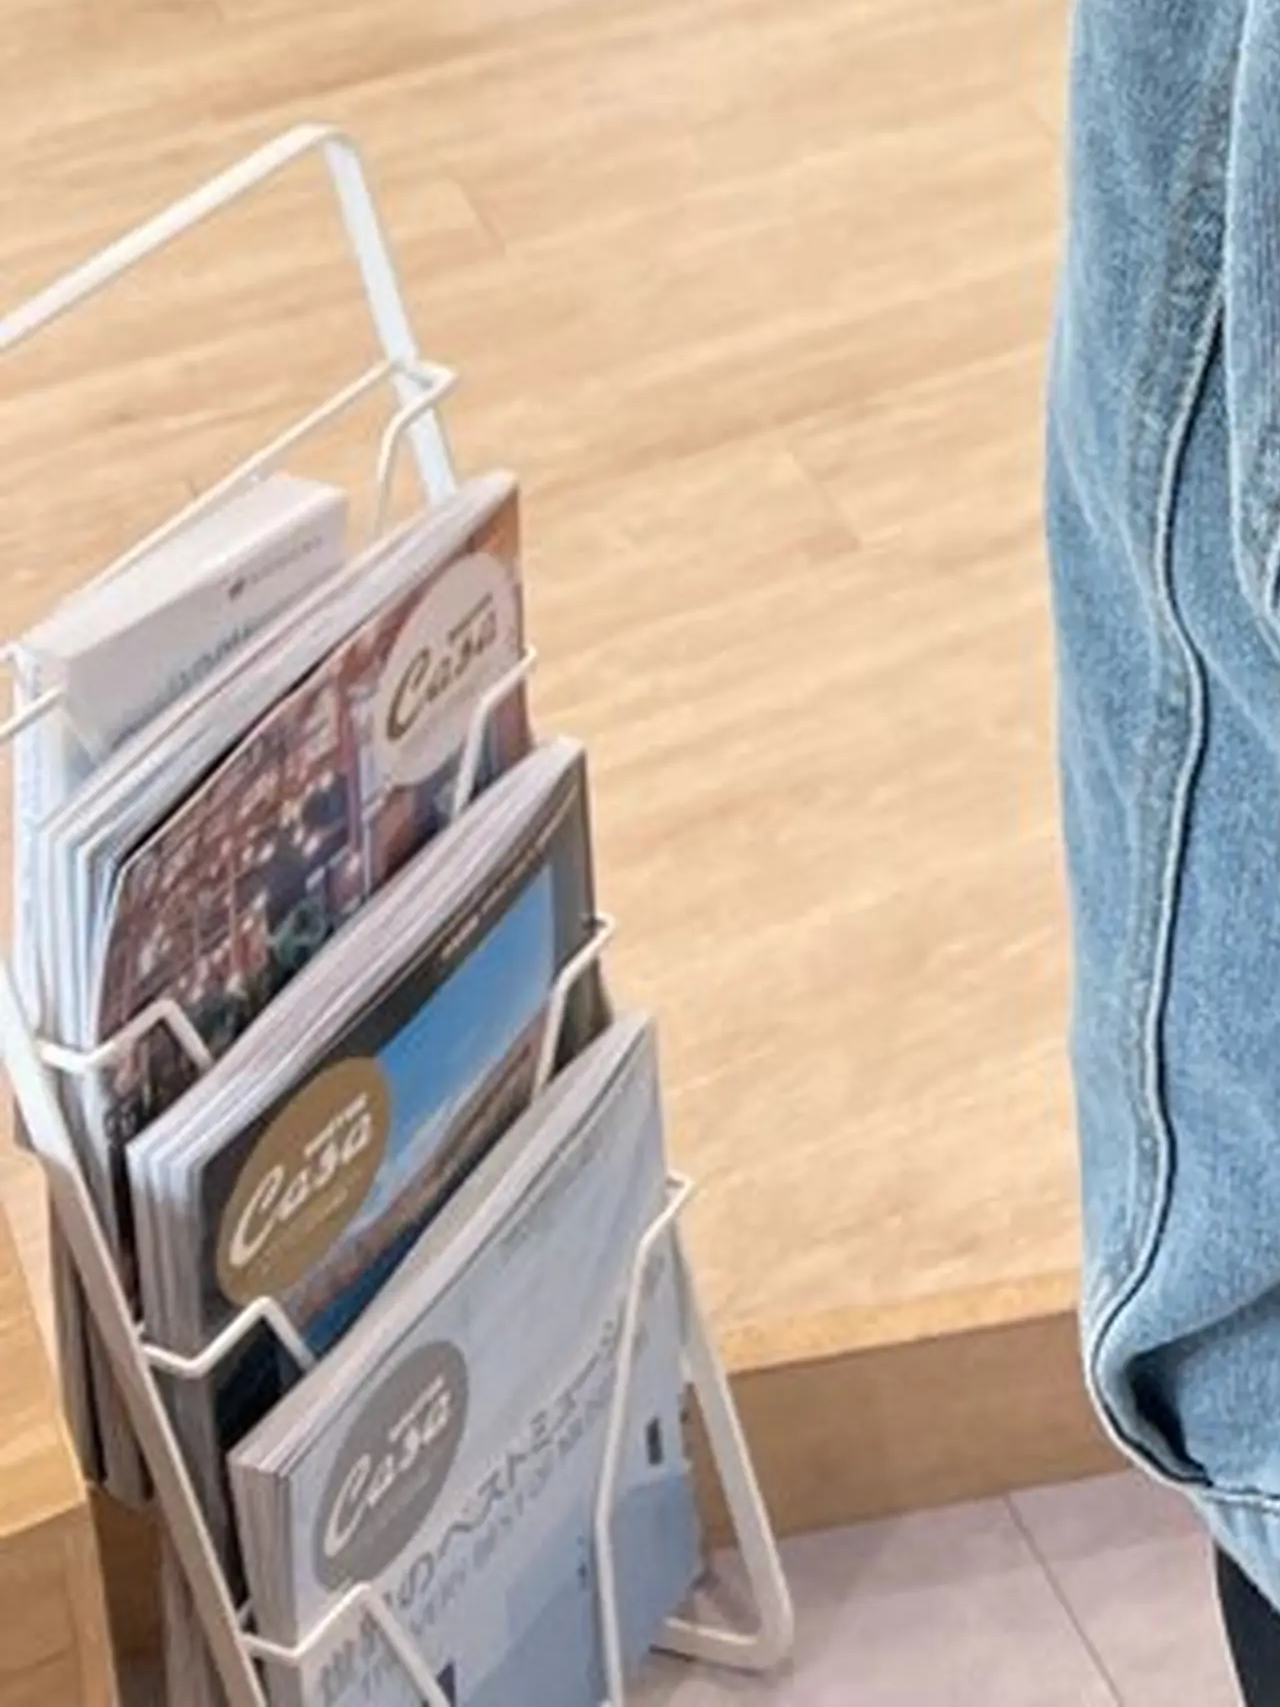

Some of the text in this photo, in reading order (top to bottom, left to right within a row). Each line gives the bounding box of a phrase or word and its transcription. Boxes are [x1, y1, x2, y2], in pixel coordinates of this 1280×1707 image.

[386, 591, 496, 741] Casa
[228, 1091, 374, 1268] Casa
[323, 1375, 451, 1558] Casa
